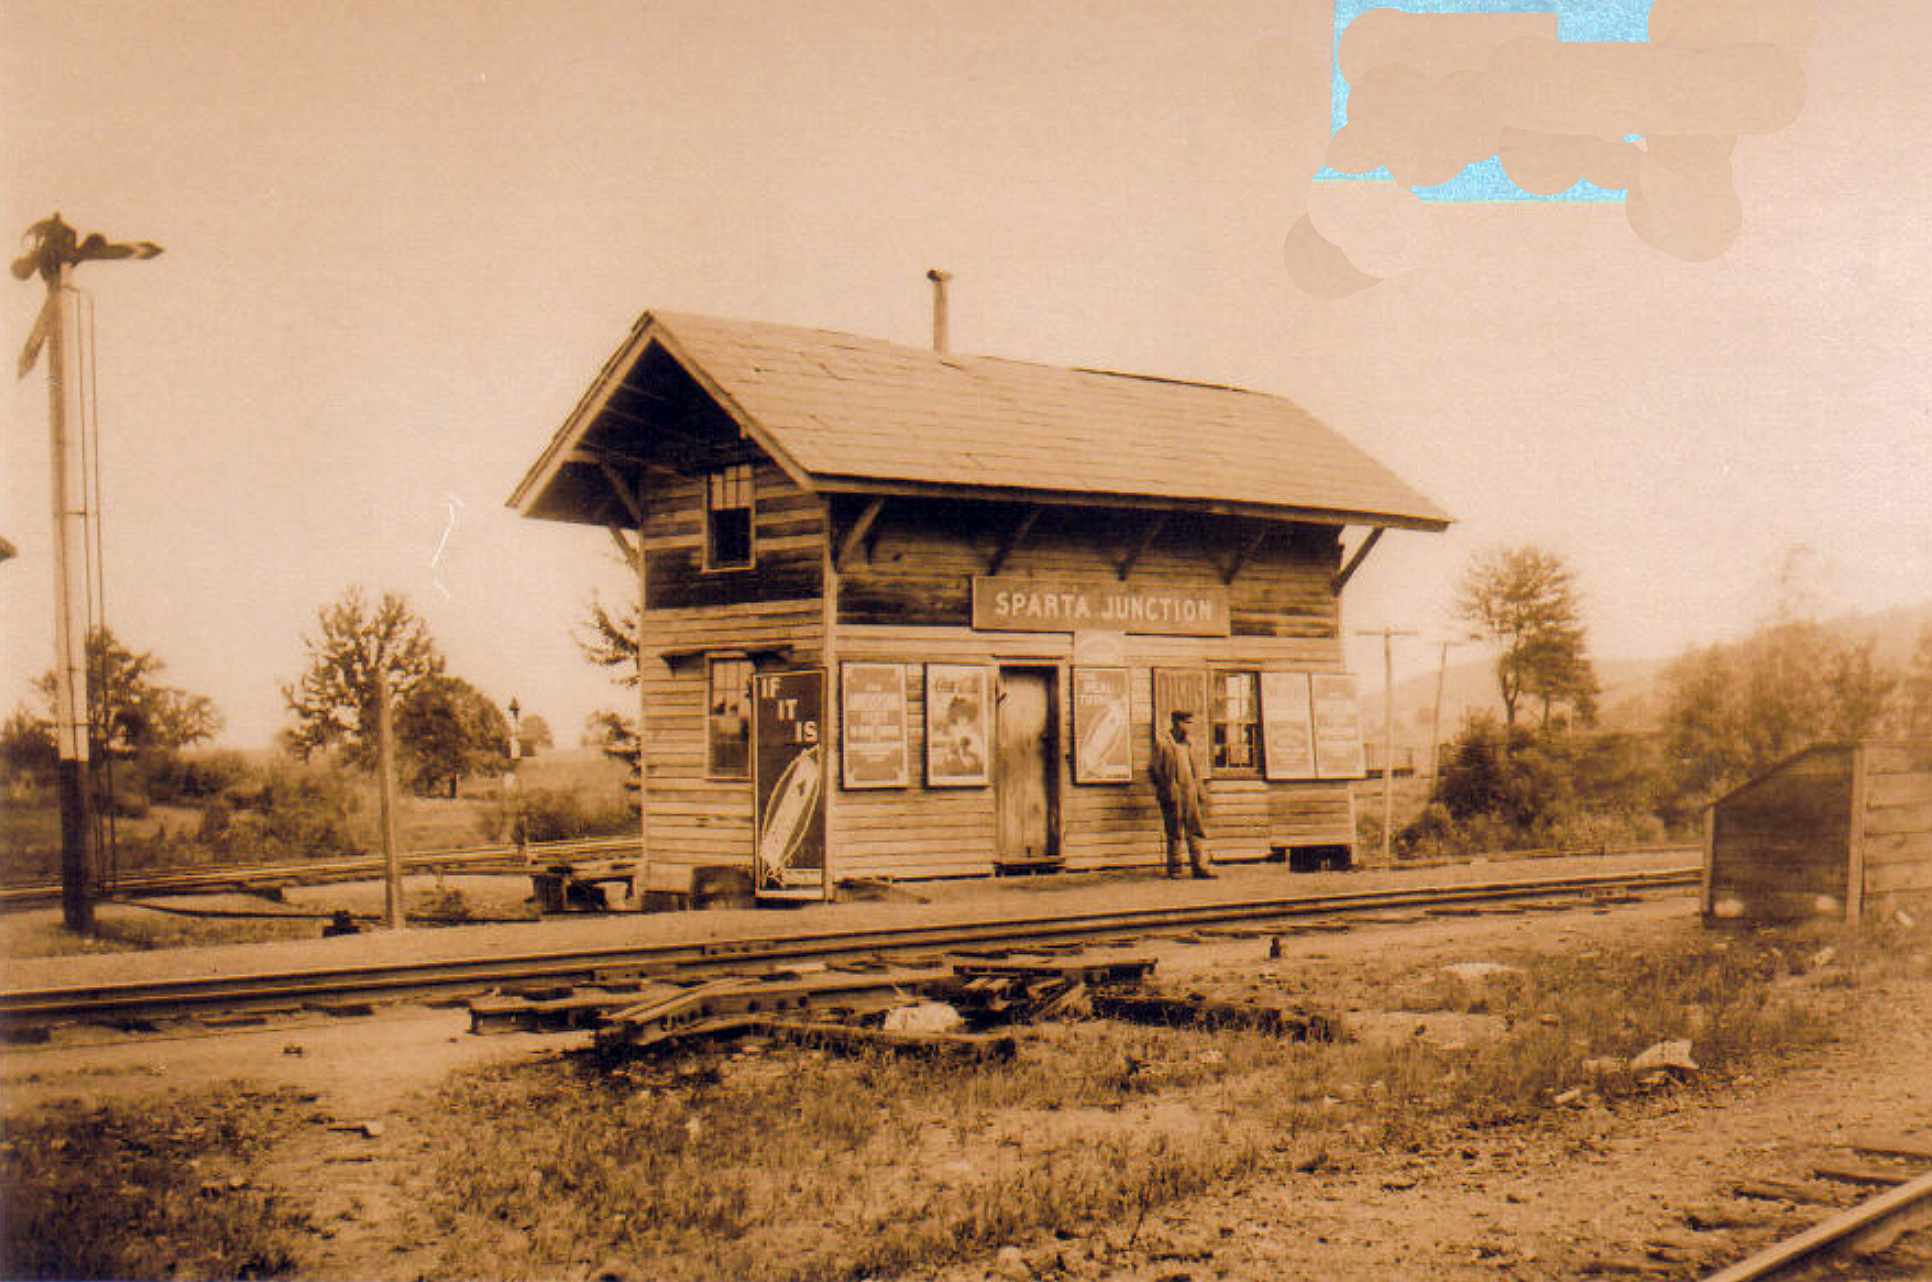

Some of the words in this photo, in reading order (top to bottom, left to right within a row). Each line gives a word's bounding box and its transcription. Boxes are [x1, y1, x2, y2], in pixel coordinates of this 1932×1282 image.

[995, 591, 1091, 619] SPARTA
[1100, 595, 1213, 622] JUNCTION
[761, 677, 782, 698] IF
[777, 698, 798, 720] IT
[795, 721, 818, 742] IS
